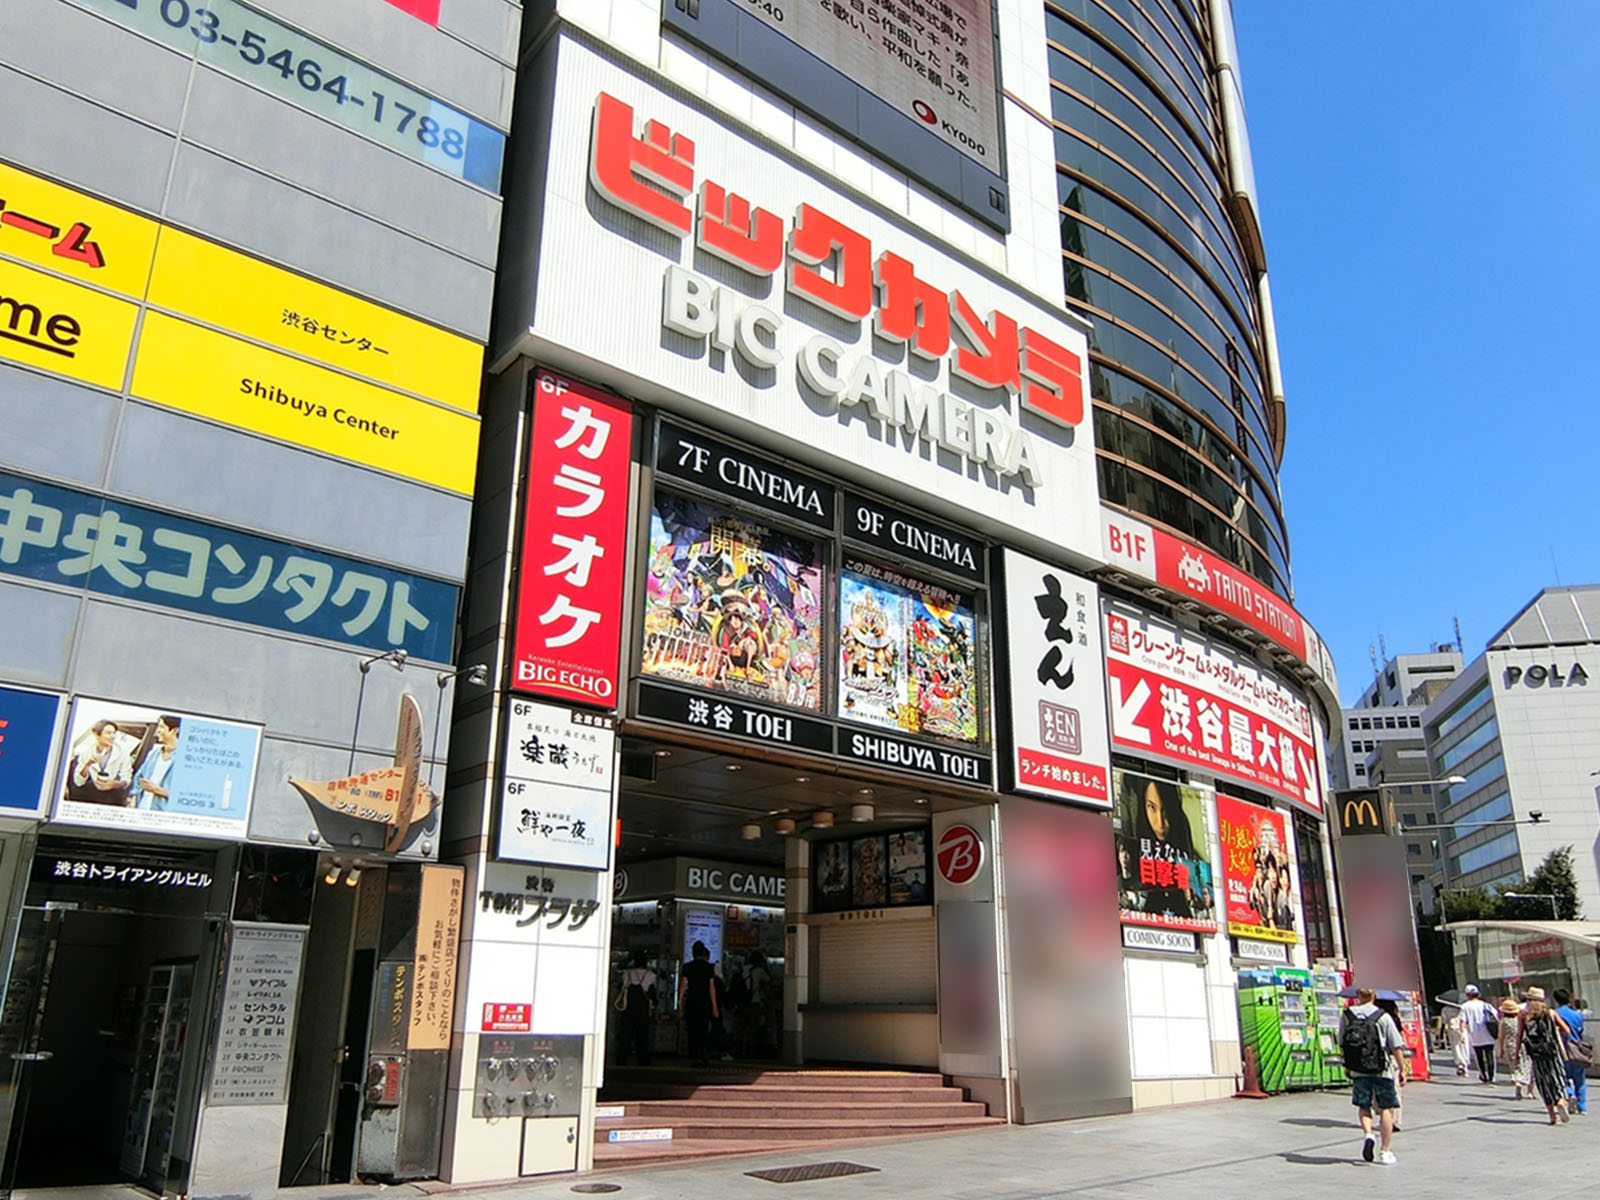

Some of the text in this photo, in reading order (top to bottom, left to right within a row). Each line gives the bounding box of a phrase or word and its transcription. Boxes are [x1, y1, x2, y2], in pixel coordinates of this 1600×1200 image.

[747, 0, 784, 22] :40
[159, 0, 464, 160] 03-5464-1788
[941, 120, 986, 155] KYODO
[0, 199, 106, 268] ーム
[590, 90, 1085, 428] ビックカメラ
[281, 308, 389, 356] 渋谷センター
[540, 374, 569, 397] 6F
[663, 264, 1043, 488] BIC CAMERA
[239, 378, 400, 441] Shibuya Center
[677, 440, 825, 517] 7F CINEMA
[538, 405, 611, 649] カラオケ
[857, 507, 977, 571] 9F CINEMA
[1109, 524, 1145, 561] B1F
[0, 488, 430, 646] 中央コンタクト
[1213, 569, 1298, 643] TAITO STATION
[1034, 574, 1074, 690] えん
[518, 660, 612, 697] BIG ECHO
[1506, 662, 1588, 686] POLA
[514, 703, 532, 716] 6F
[688, 698, 792, 741] 渋谷 TOEI
[1056, 711, 1076, 736] EN
[1160, 683, 1298, 784] 渋谷最大級
[852, 735, 979, 779] SHIBUYA TOEI
[508, 782, 526, 795] 6F
[1141, 838, 1188, 863] 見えない
[54, 861, 212, 889] 渋谷トライアングルビル
[688, 867, 722, 890] BIC
[1140, 857, 1190, 889] 目撃者
[1127, 930, 1192, 947] COMING SOON
[244, 1003, 286, 1012] セントラル
[256, 1015, 285, 1025] アコム
